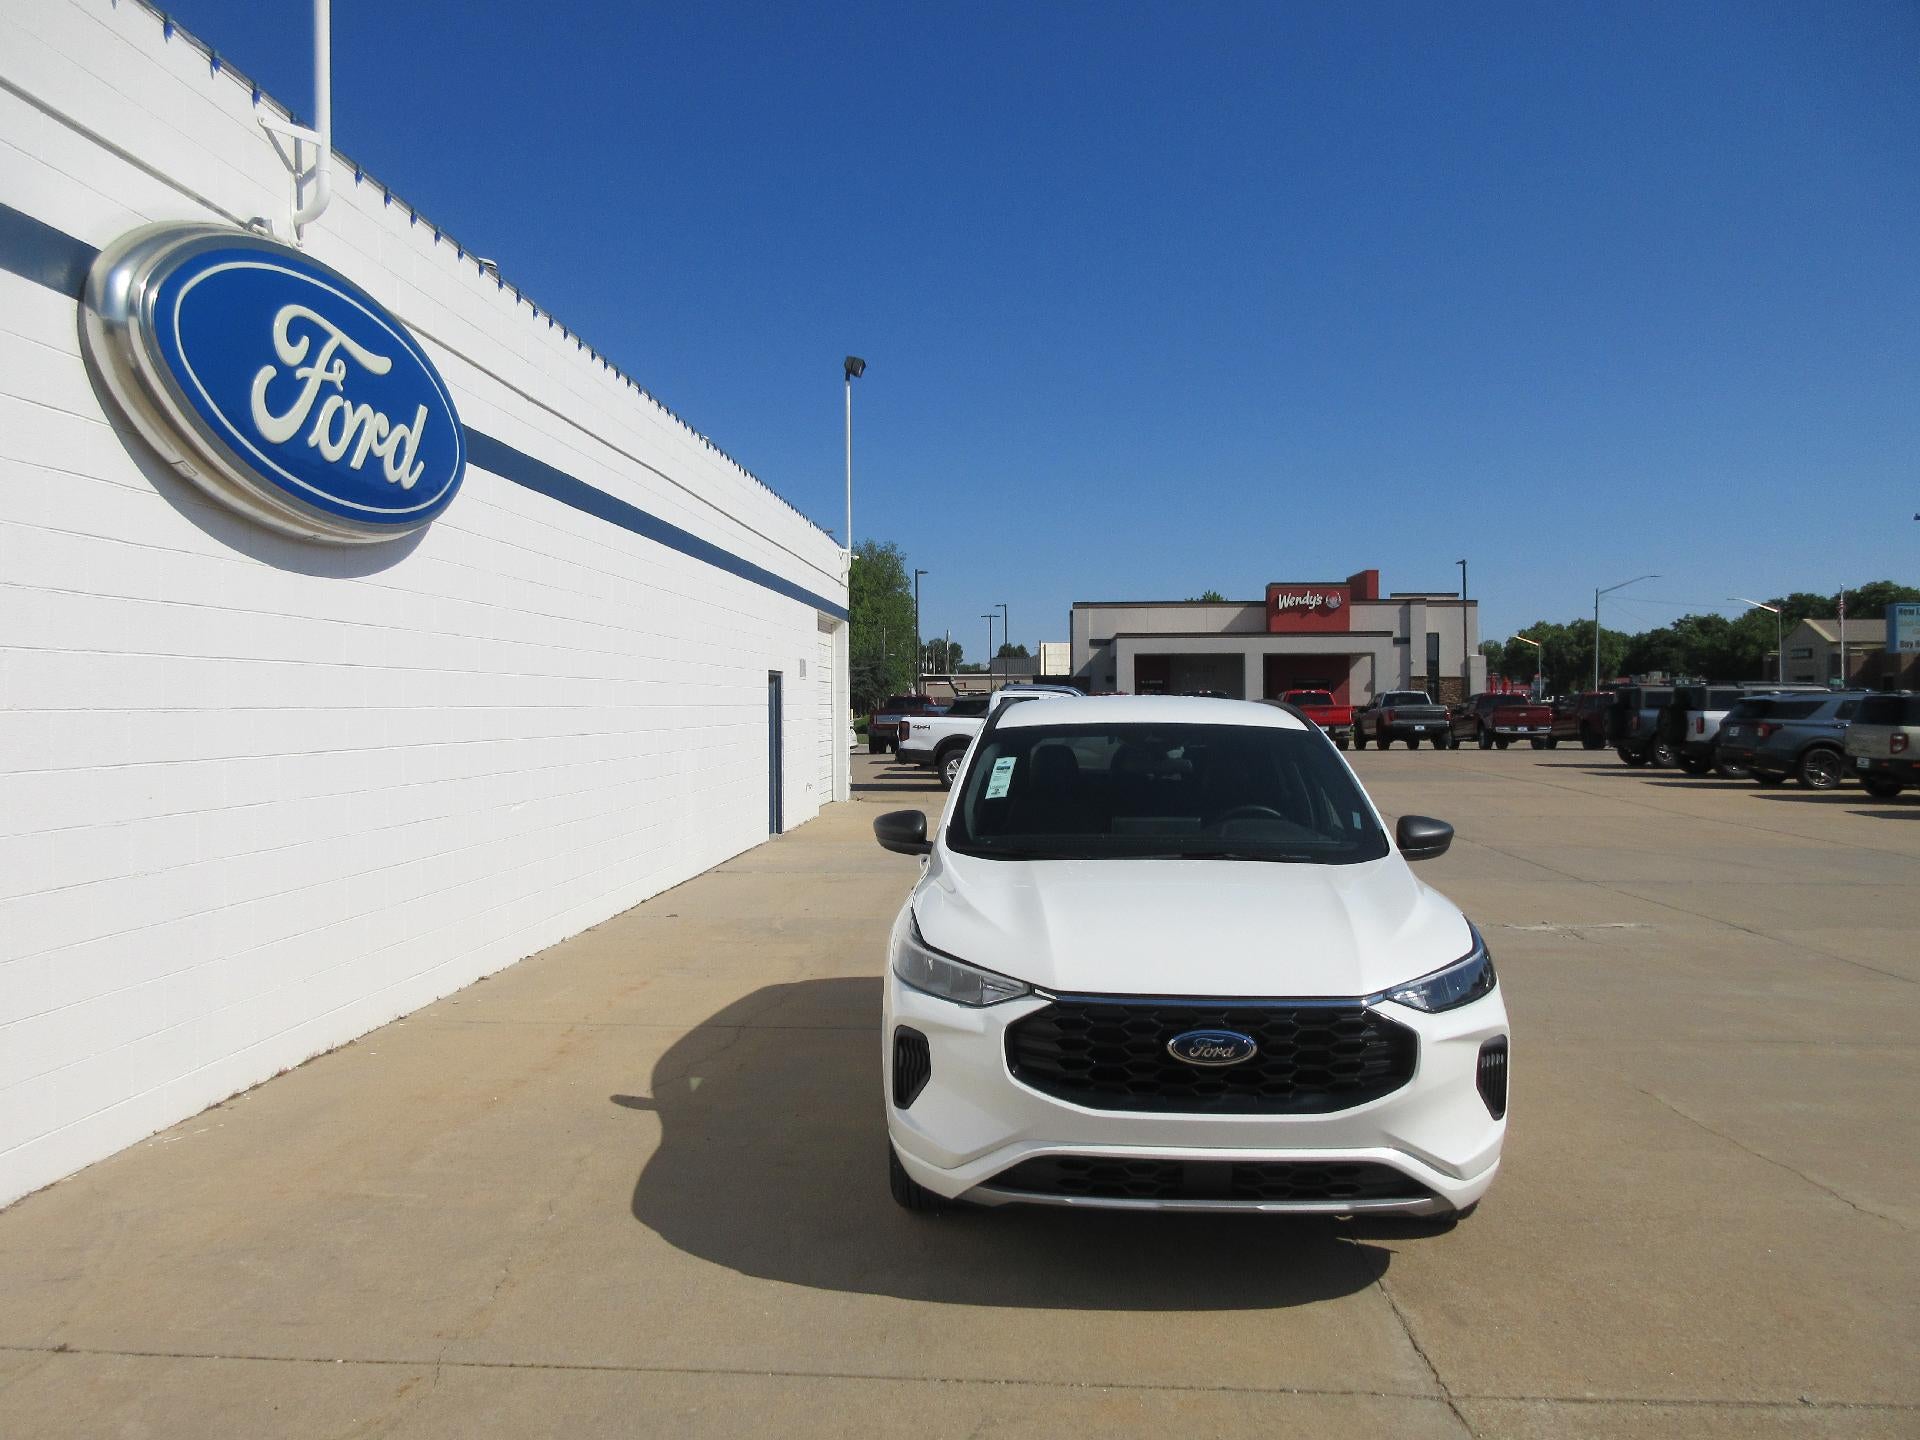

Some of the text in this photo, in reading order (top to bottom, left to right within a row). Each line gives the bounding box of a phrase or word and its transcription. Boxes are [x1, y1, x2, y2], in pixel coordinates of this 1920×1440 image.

[250, 303, 429, 491] Ford
[1278, 590, 1323, 610] Wendy's
[1189, 1037, 1236, 1058] Ford
